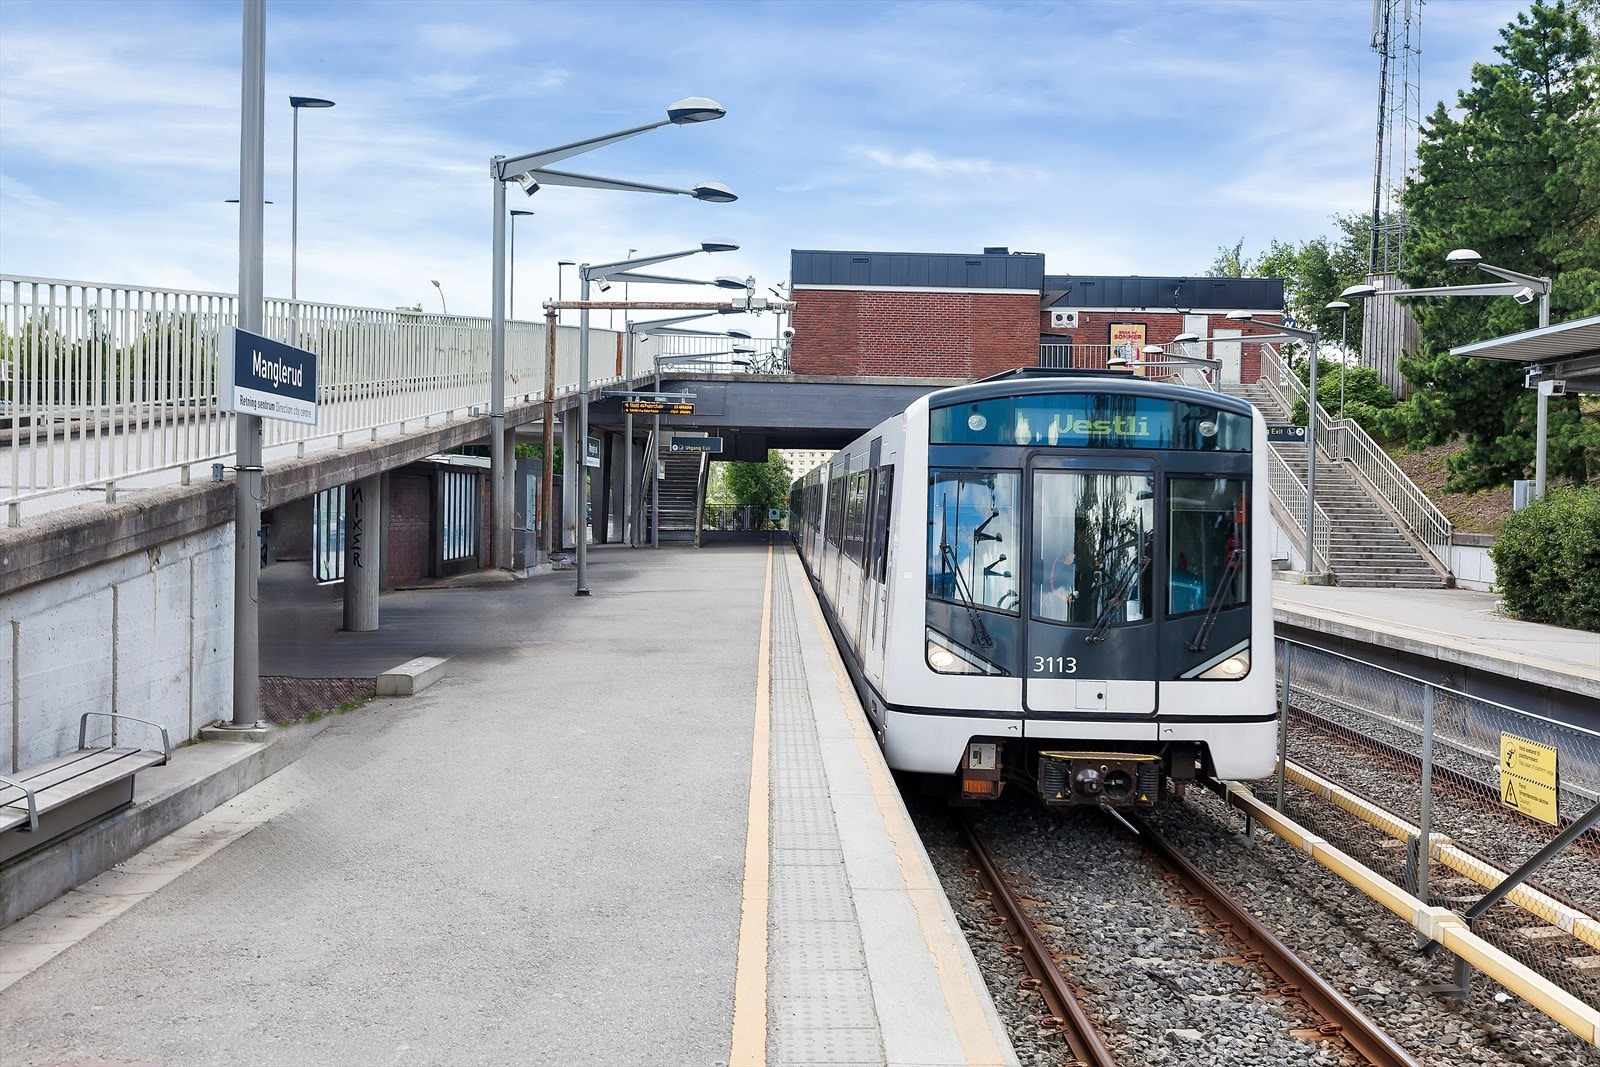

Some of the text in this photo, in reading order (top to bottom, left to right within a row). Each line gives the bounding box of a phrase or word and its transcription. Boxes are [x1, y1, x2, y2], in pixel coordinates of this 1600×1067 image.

[252, 350, 303, 388] Manglerud
[239, 394, 257, 411] Retning
[257, 400, 276, 412] sentrum
[276, 401, 293, 415] Direction
[1053, 413, 1150, 437] Vestli
[1033, 655, 1077, 674] 3113
